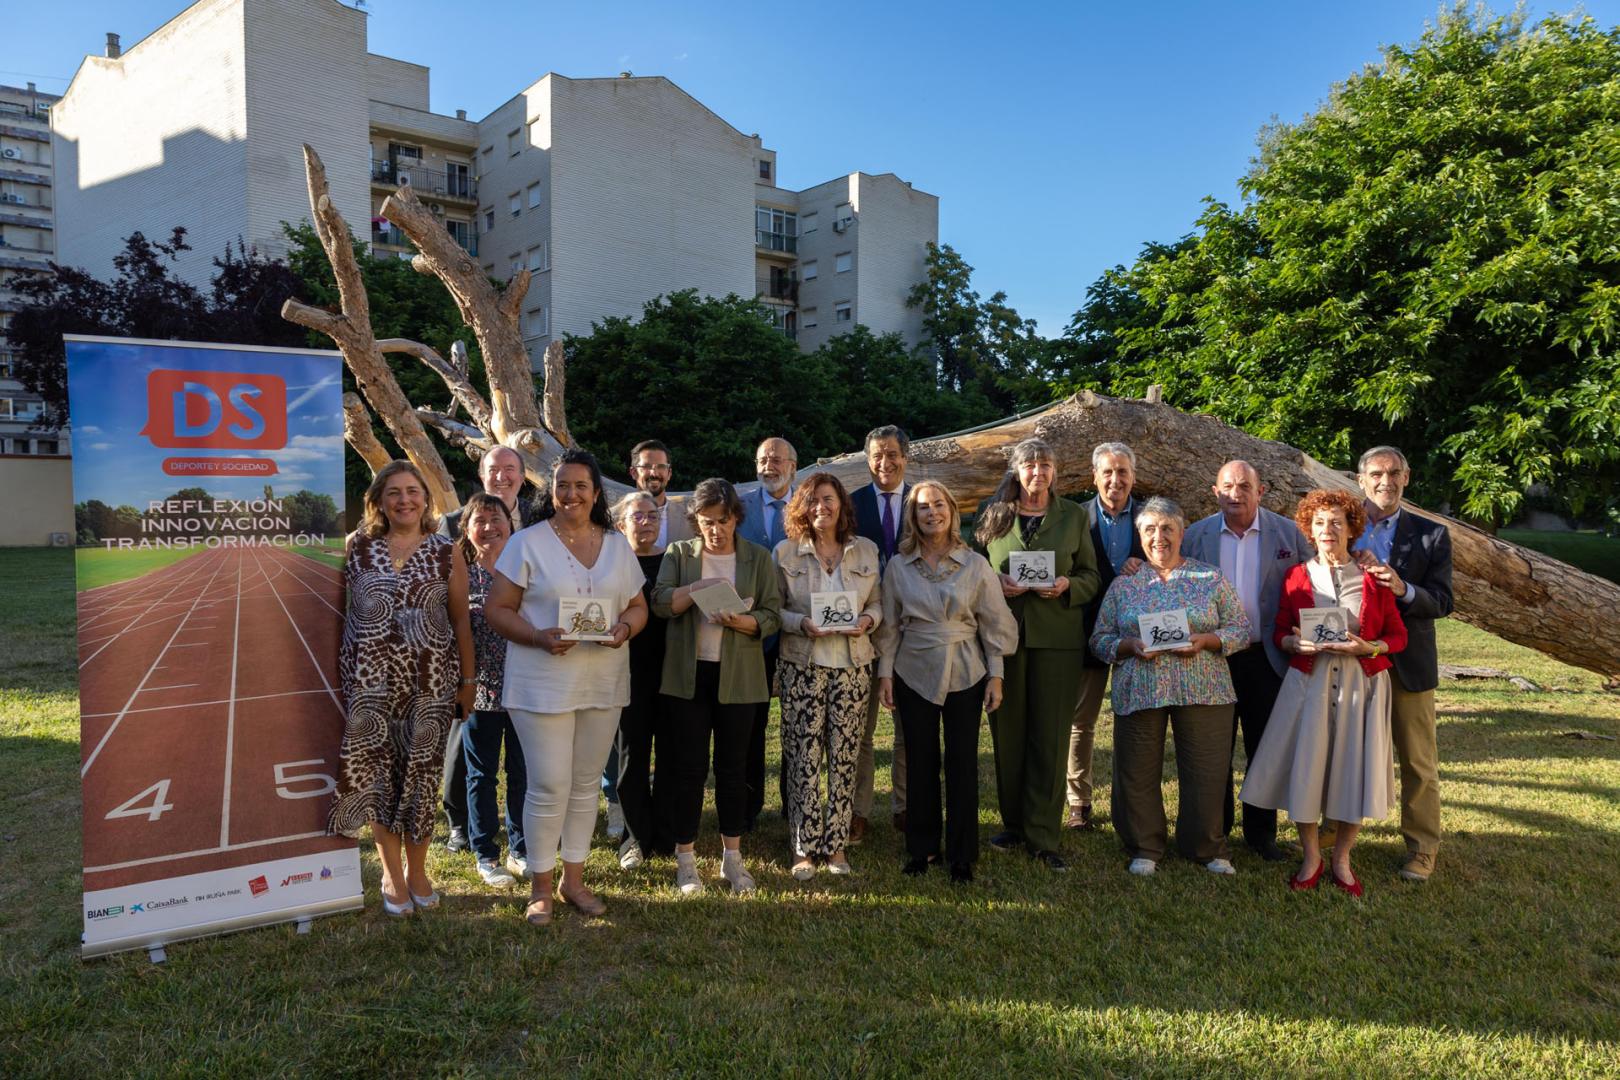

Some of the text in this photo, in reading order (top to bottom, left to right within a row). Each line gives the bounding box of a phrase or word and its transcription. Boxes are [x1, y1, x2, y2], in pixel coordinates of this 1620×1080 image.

[173, 381, 266, 440] DS
[222, 463, 269, 471] SOCIEDAD
[149, 496, 283, 514] REFLEXIÓN
[142, 514, 291, 532] INNOVACIÓN
[100, 531, 325, 551] TRANSFORMACIÓN
[273, 759, 339, 800] 5
[104, 778, 174, 821] 4
[146, 896, 189, 910] CaixaBank
